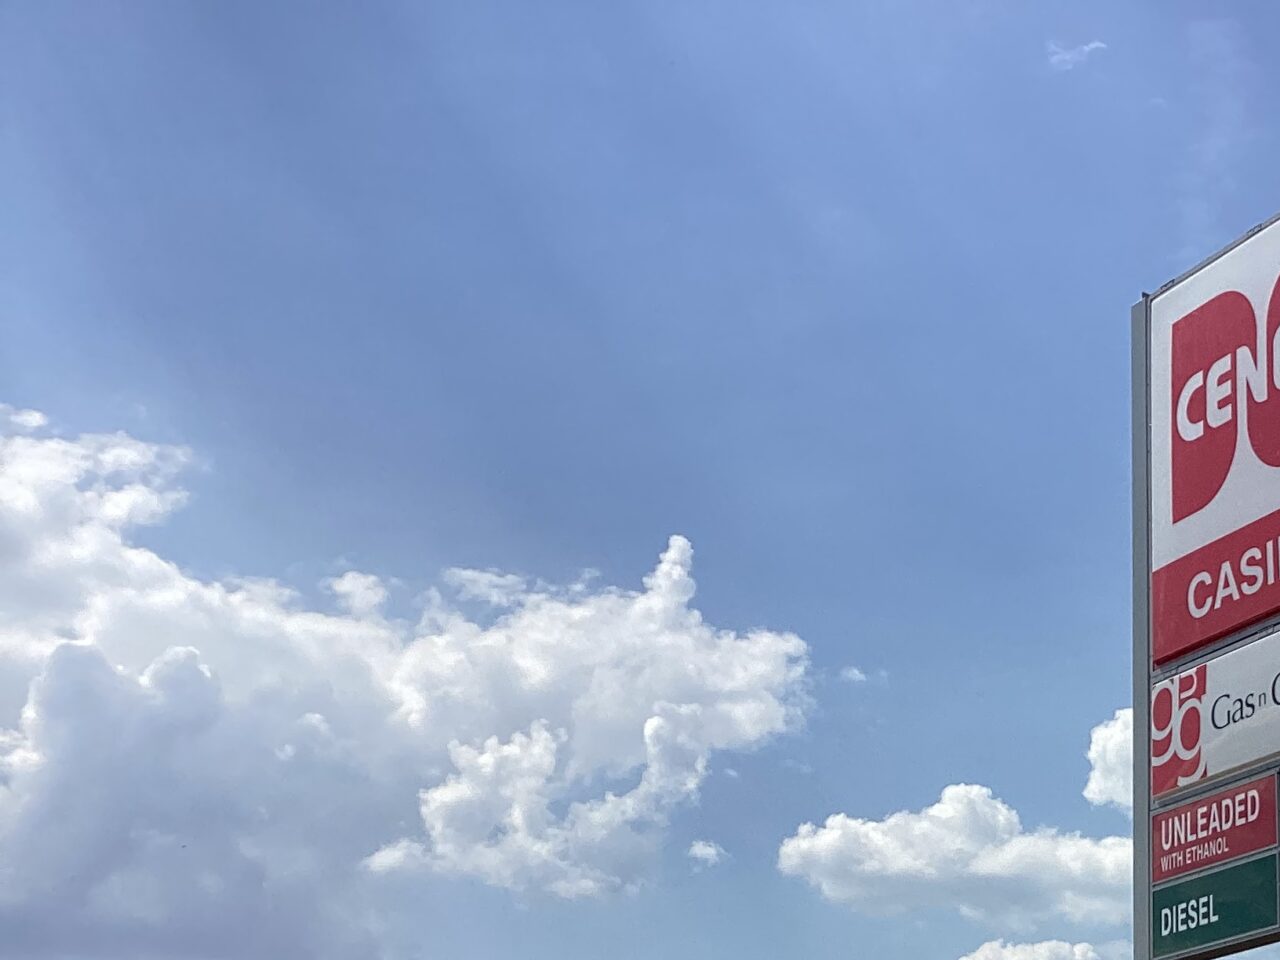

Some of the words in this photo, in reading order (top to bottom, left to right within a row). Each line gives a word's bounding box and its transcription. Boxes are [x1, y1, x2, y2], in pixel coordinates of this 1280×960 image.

[1211, 694, 1255, 730] Gas
[1258, 692, 1267, 707] n
[1161, 789, 1260, 851] UNLEADED
[1160, 851, 1184, 872] WITH
[1185, 837, 1230, 864] ETHANOL
[1161, 894, 1219, 937] DIESEL
